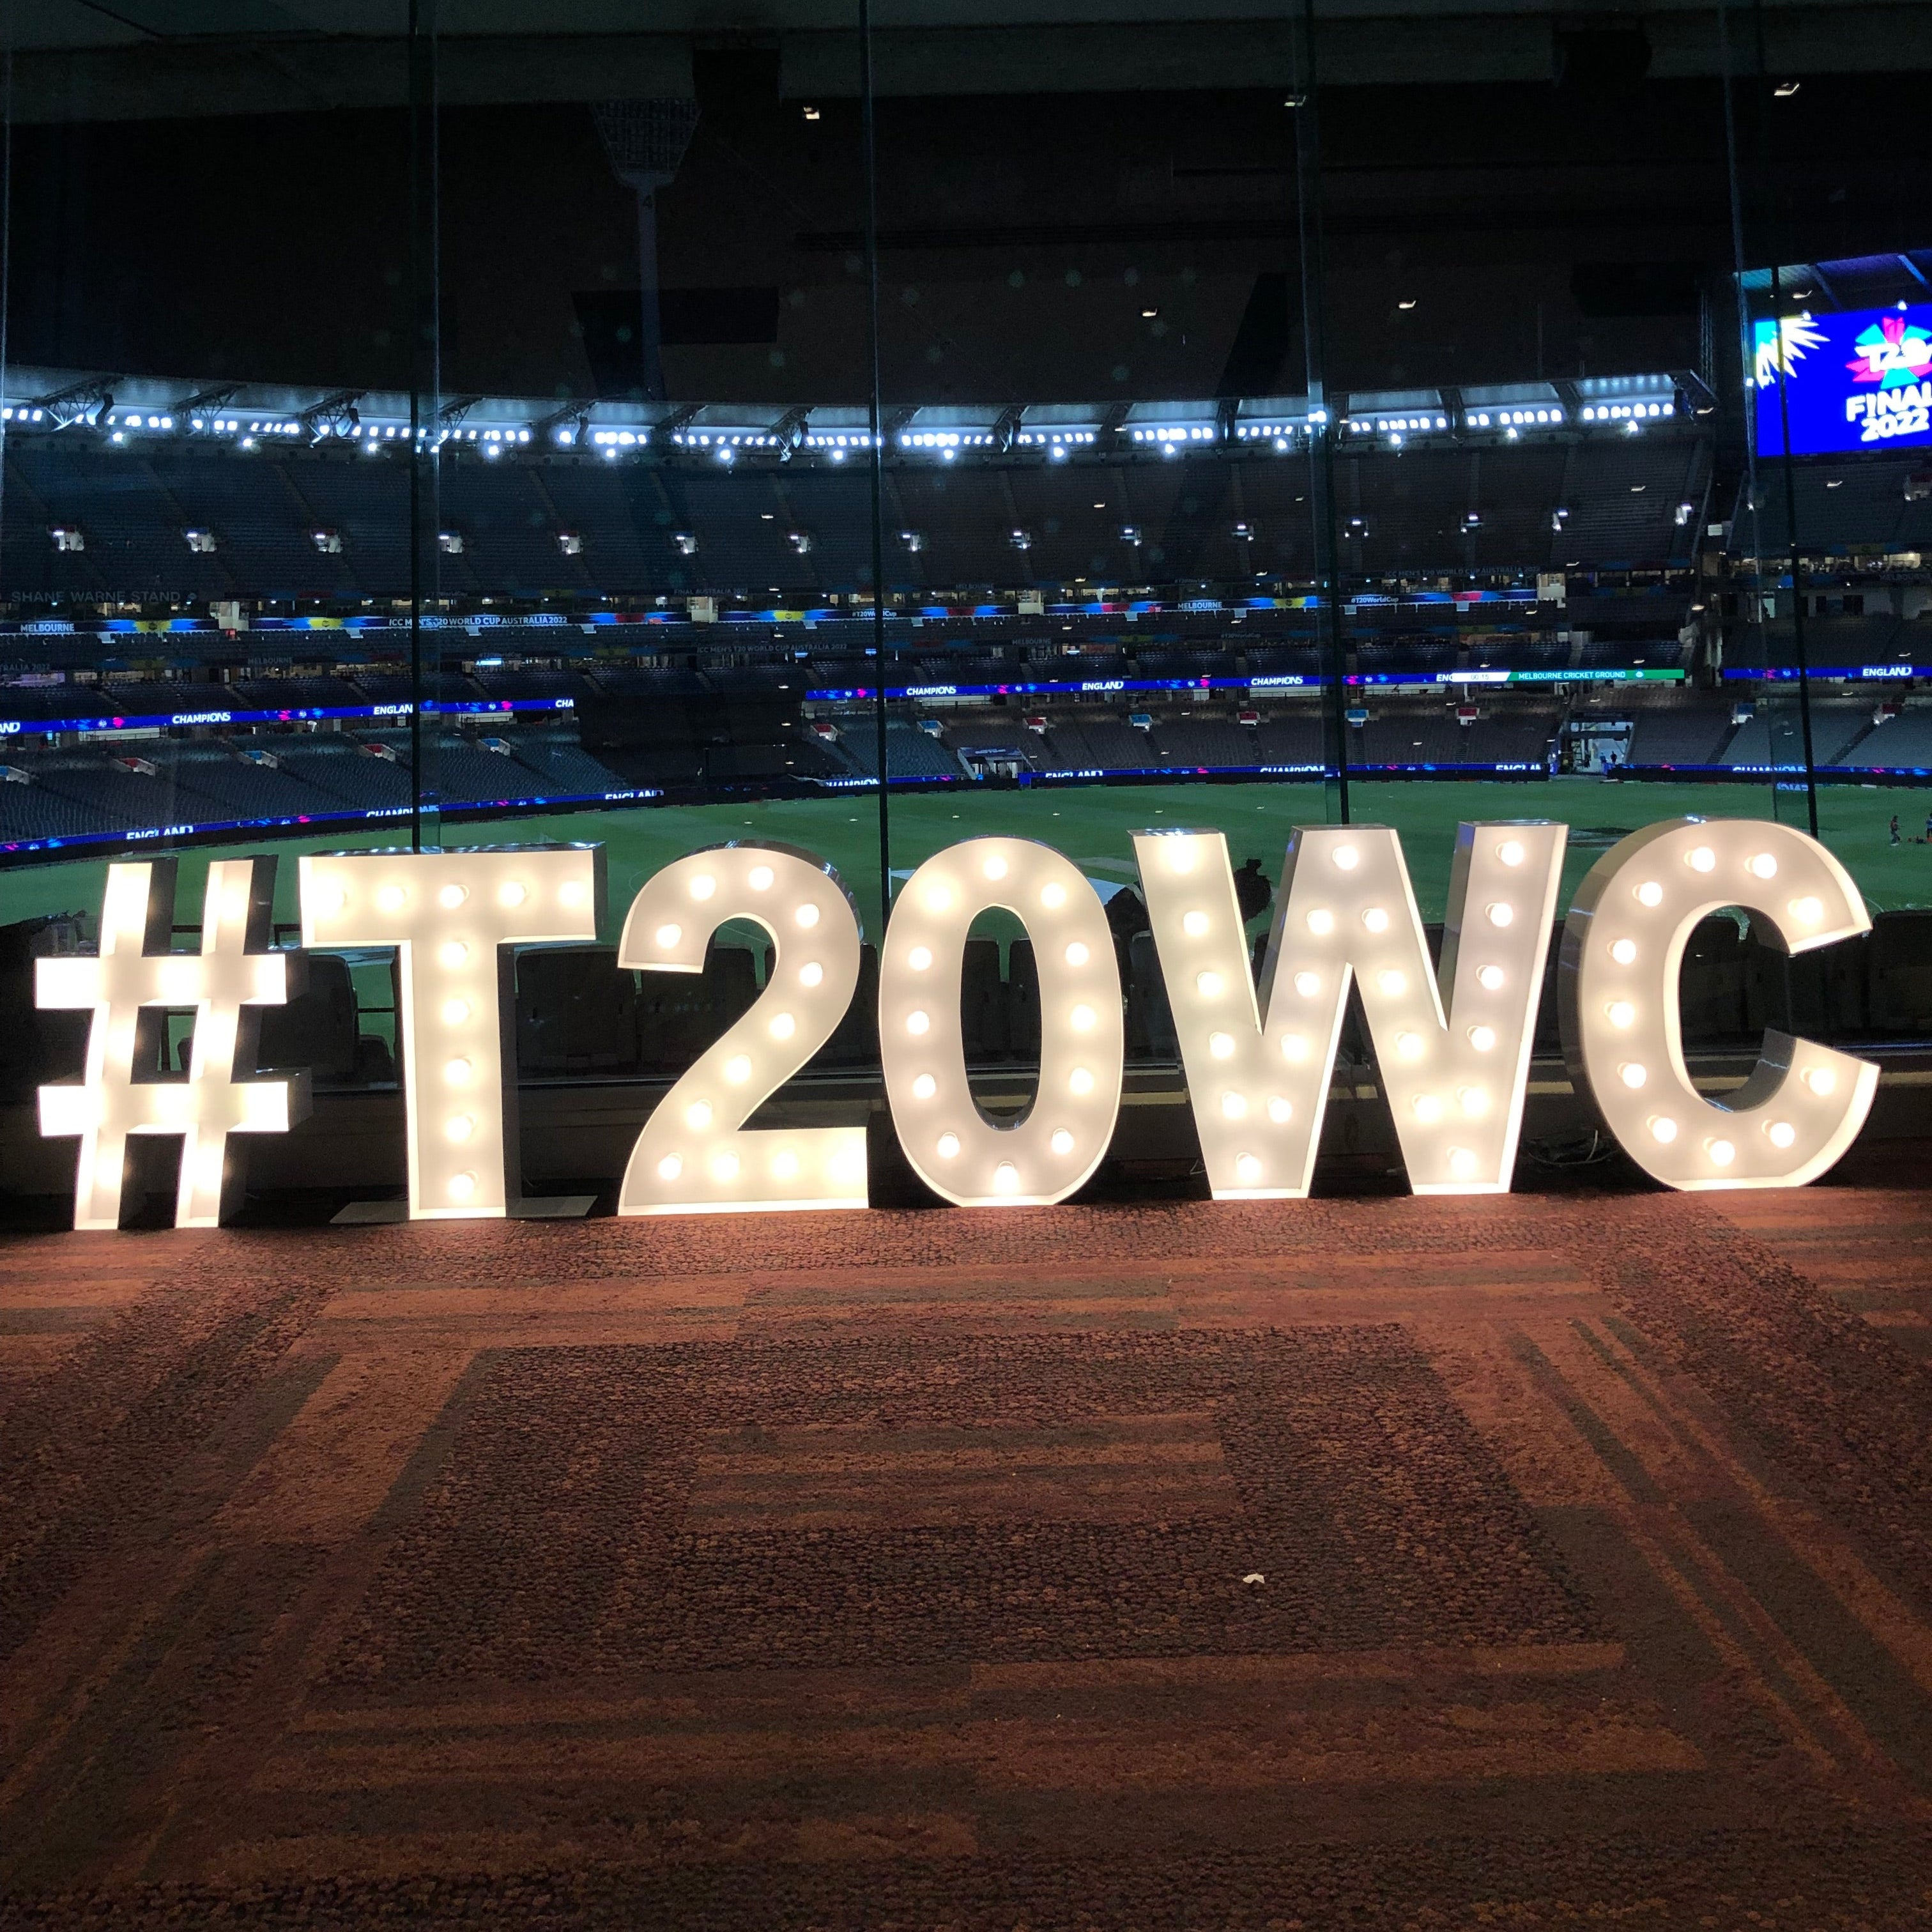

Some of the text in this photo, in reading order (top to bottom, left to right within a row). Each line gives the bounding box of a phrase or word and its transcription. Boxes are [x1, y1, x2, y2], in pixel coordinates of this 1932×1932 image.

[1846, 381, 1932, 422] FINAL
[1860, 408, 1929, 442] 2022
[11, 591, 181, 602] SHANE WARNE STAND
[388, 618, 403, 626] ICC
[449, 617, 481, 625] WORLD
[482, 617, 501, 625] CUP
[502, 617, 548, 625] AUSTRALIA
[549, 616, 567, 624] 2022
[20, 623, 75, 632] MELBOURNE
[1862, 667, 1912, 677] ENGLAND
[1082, 681, 1124, 691] ENGLAND
[1251, 676, 1303, 686] CHAMPIONS
[906, 686, 957, 696] CHAMPIONS
[374, 704, 413, 716] ENGLAN
[171, 711, 231, 724] CHAMPIONS
[34, 818, 1880, 1231] #T20WC
